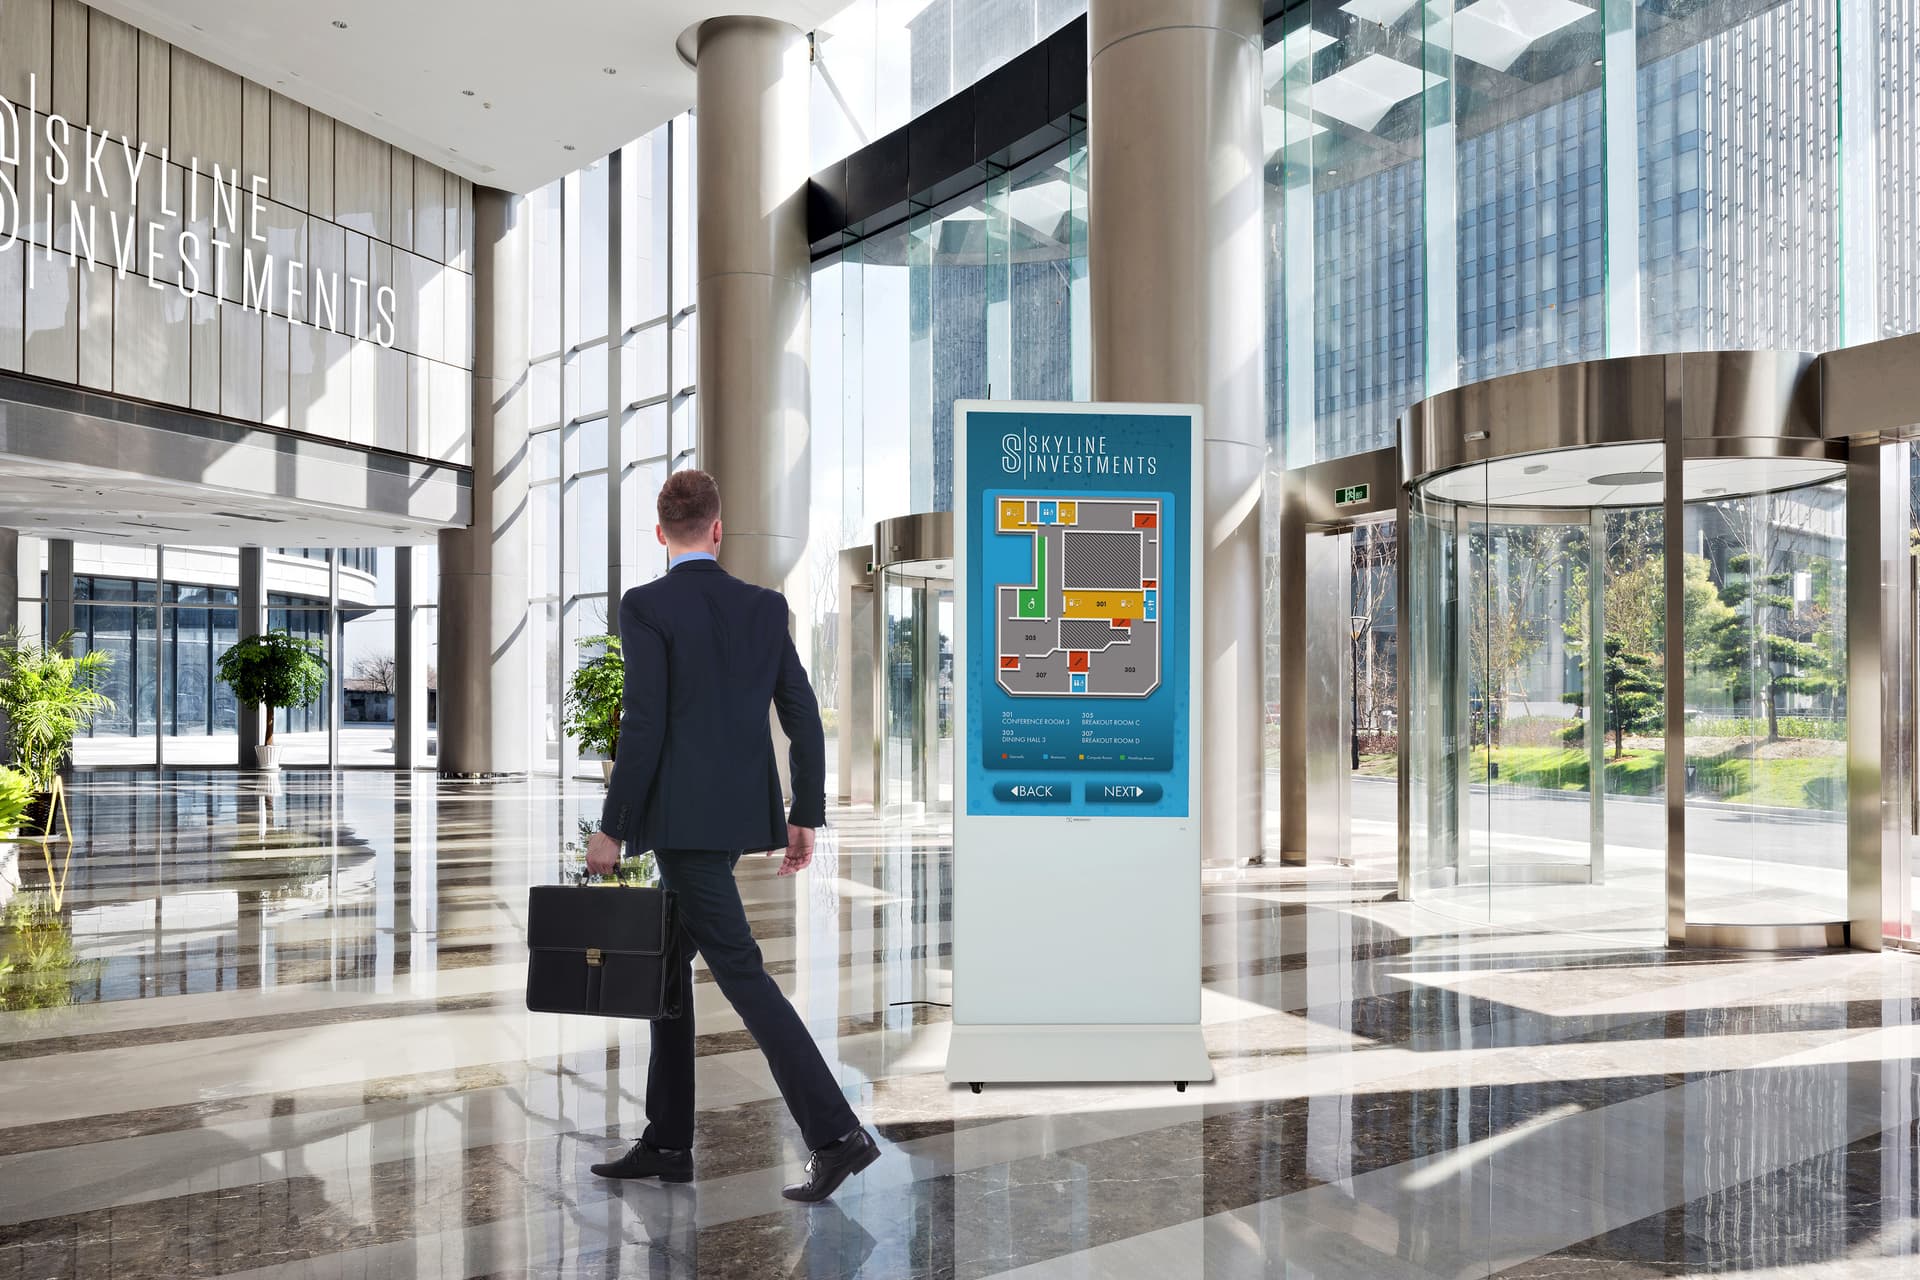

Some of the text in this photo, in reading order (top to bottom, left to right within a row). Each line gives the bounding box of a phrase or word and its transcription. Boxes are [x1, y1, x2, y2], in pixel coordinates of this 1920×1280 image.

[46, 114, 269, 243] SKYLINE
[46, 192, 397, 349] INVESTMENTS
[1029, 434, 1107, 455] SKYLINE
[1029, 456, 1157, 475] INVESTMENTS
[1019, 786, 1053, 797] BACK
[1104, 786, 1135, 797] NEXT
